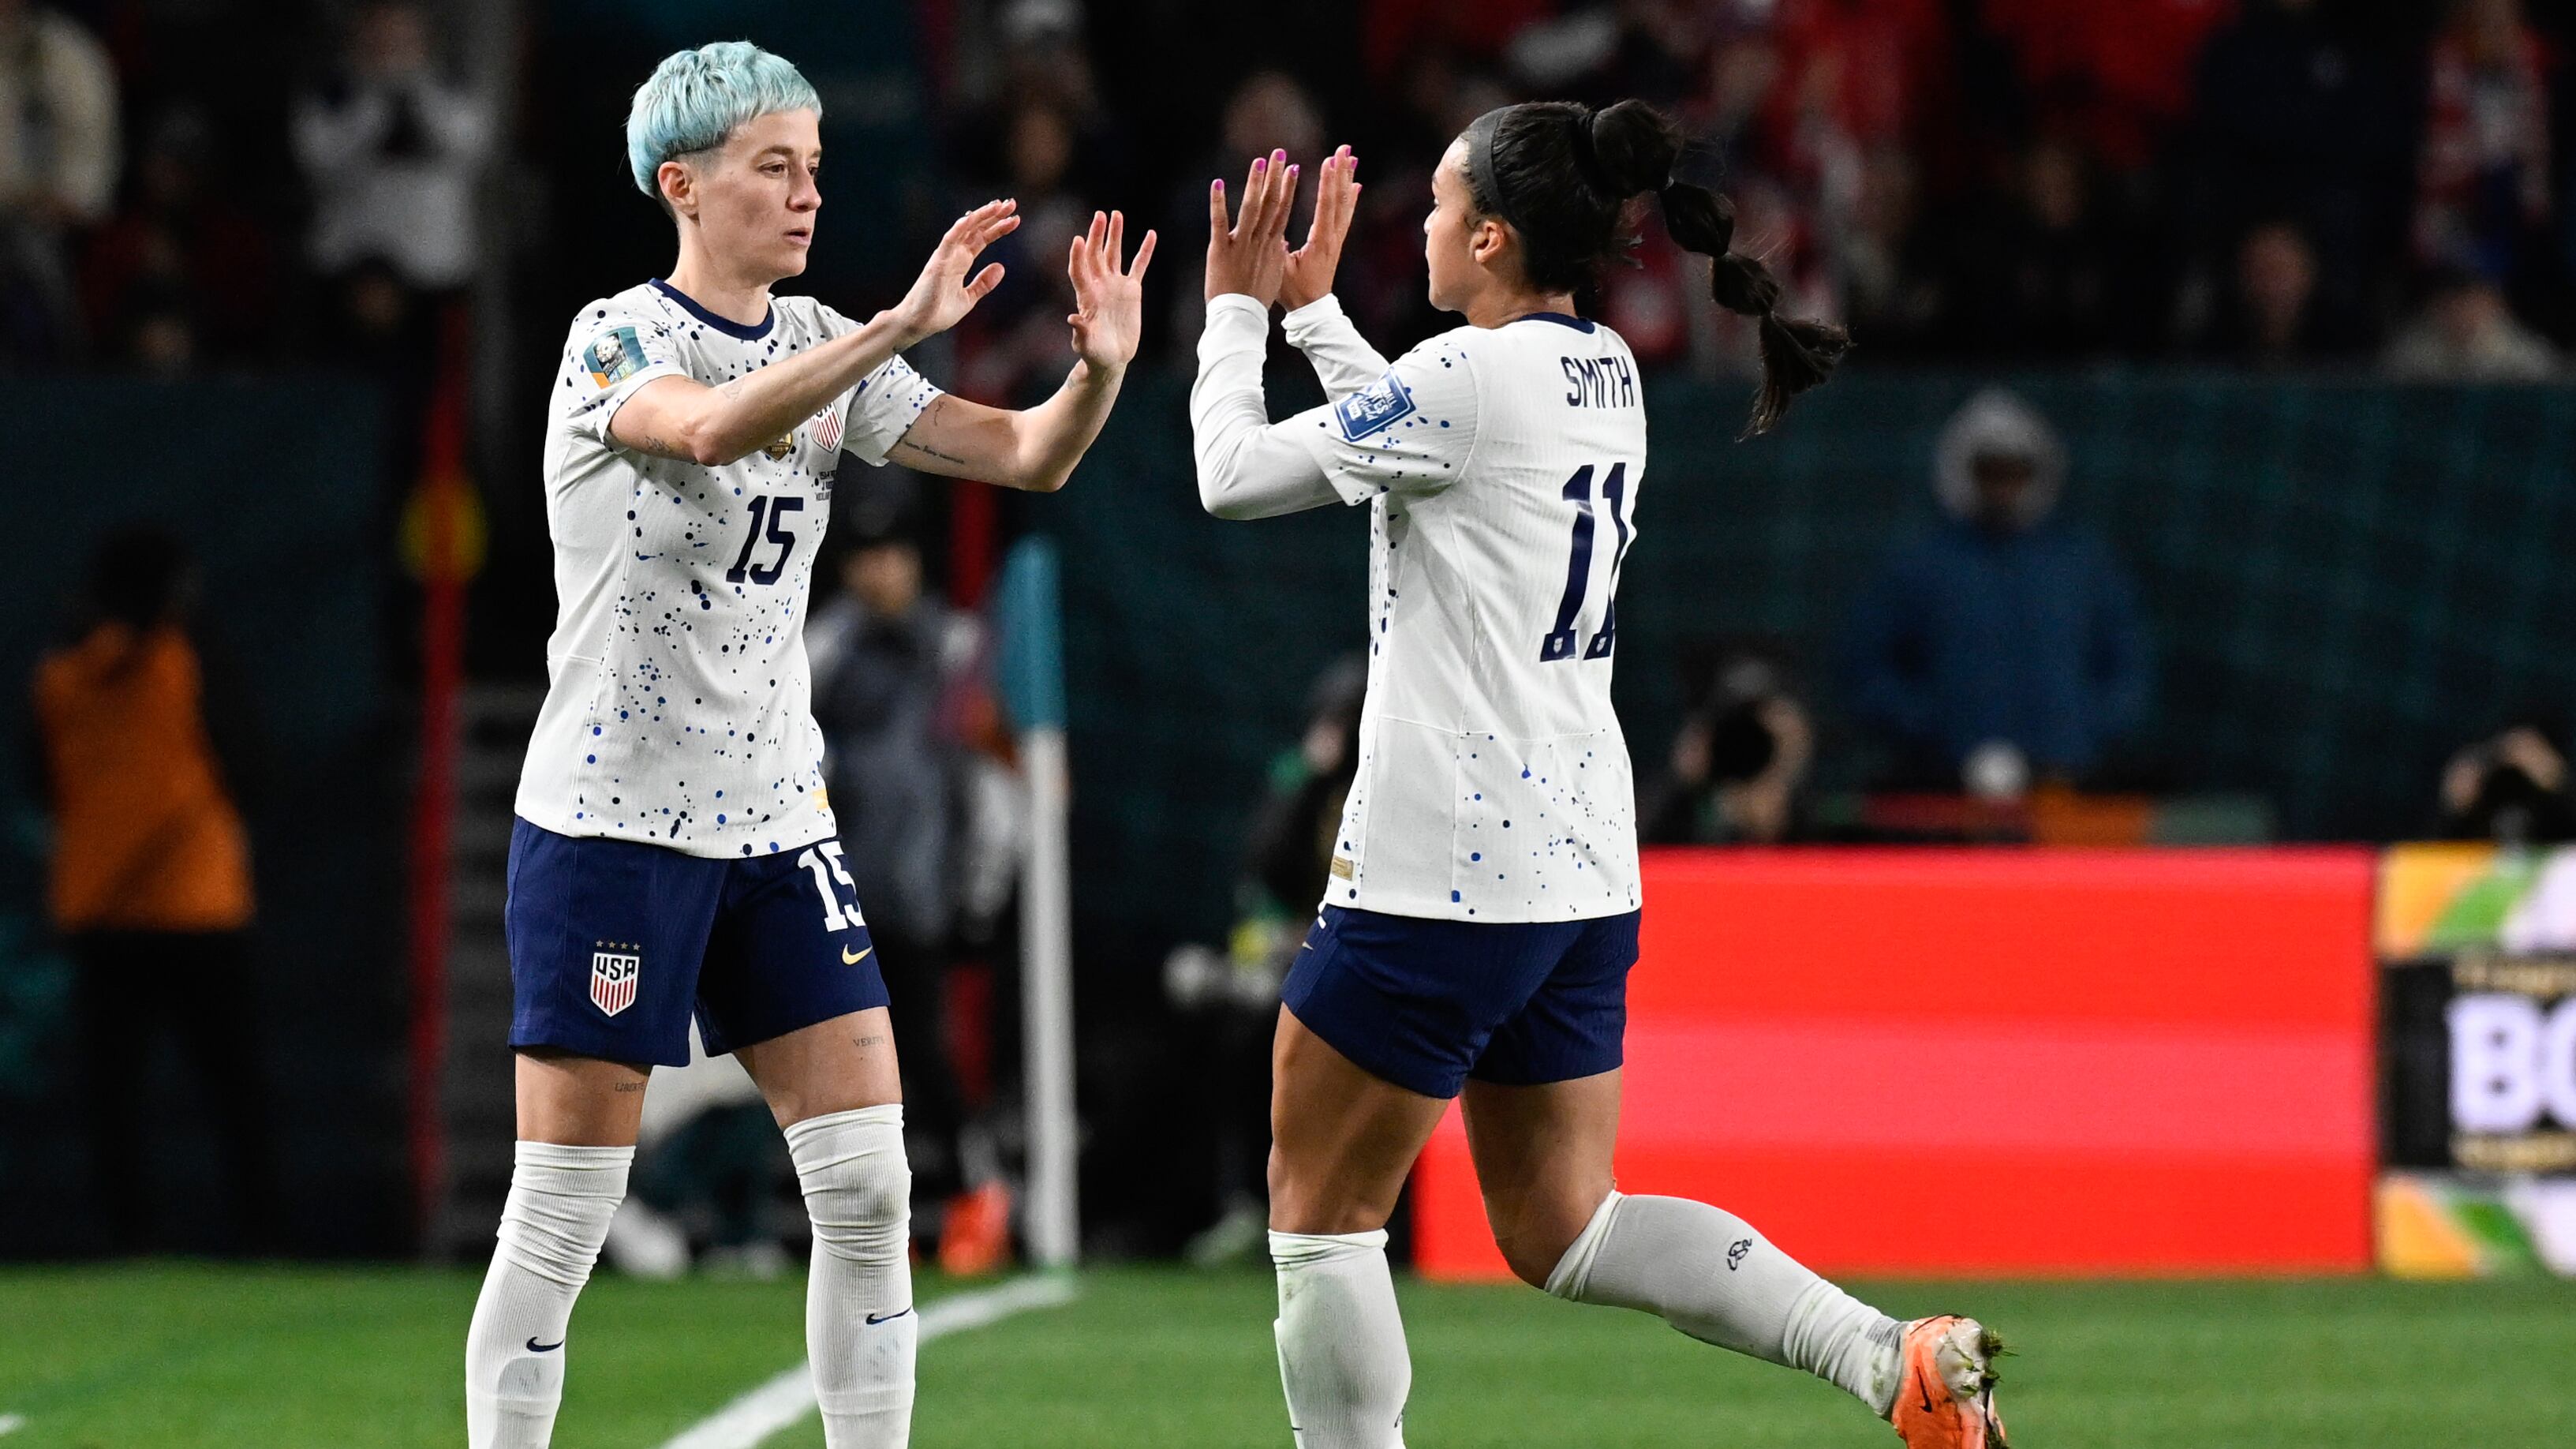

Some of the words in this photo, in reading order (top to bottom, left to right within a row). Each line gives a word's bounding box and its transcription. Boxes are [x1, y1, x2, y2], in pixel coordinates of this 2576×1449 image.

[1561, 355, 1634, 409] SMITH
[726, 495, 804, 585] 15
[1539, 462, 1628, 662] 11
[798, 841, 866, 932] 15
[596, 956, 637, 981] USA
